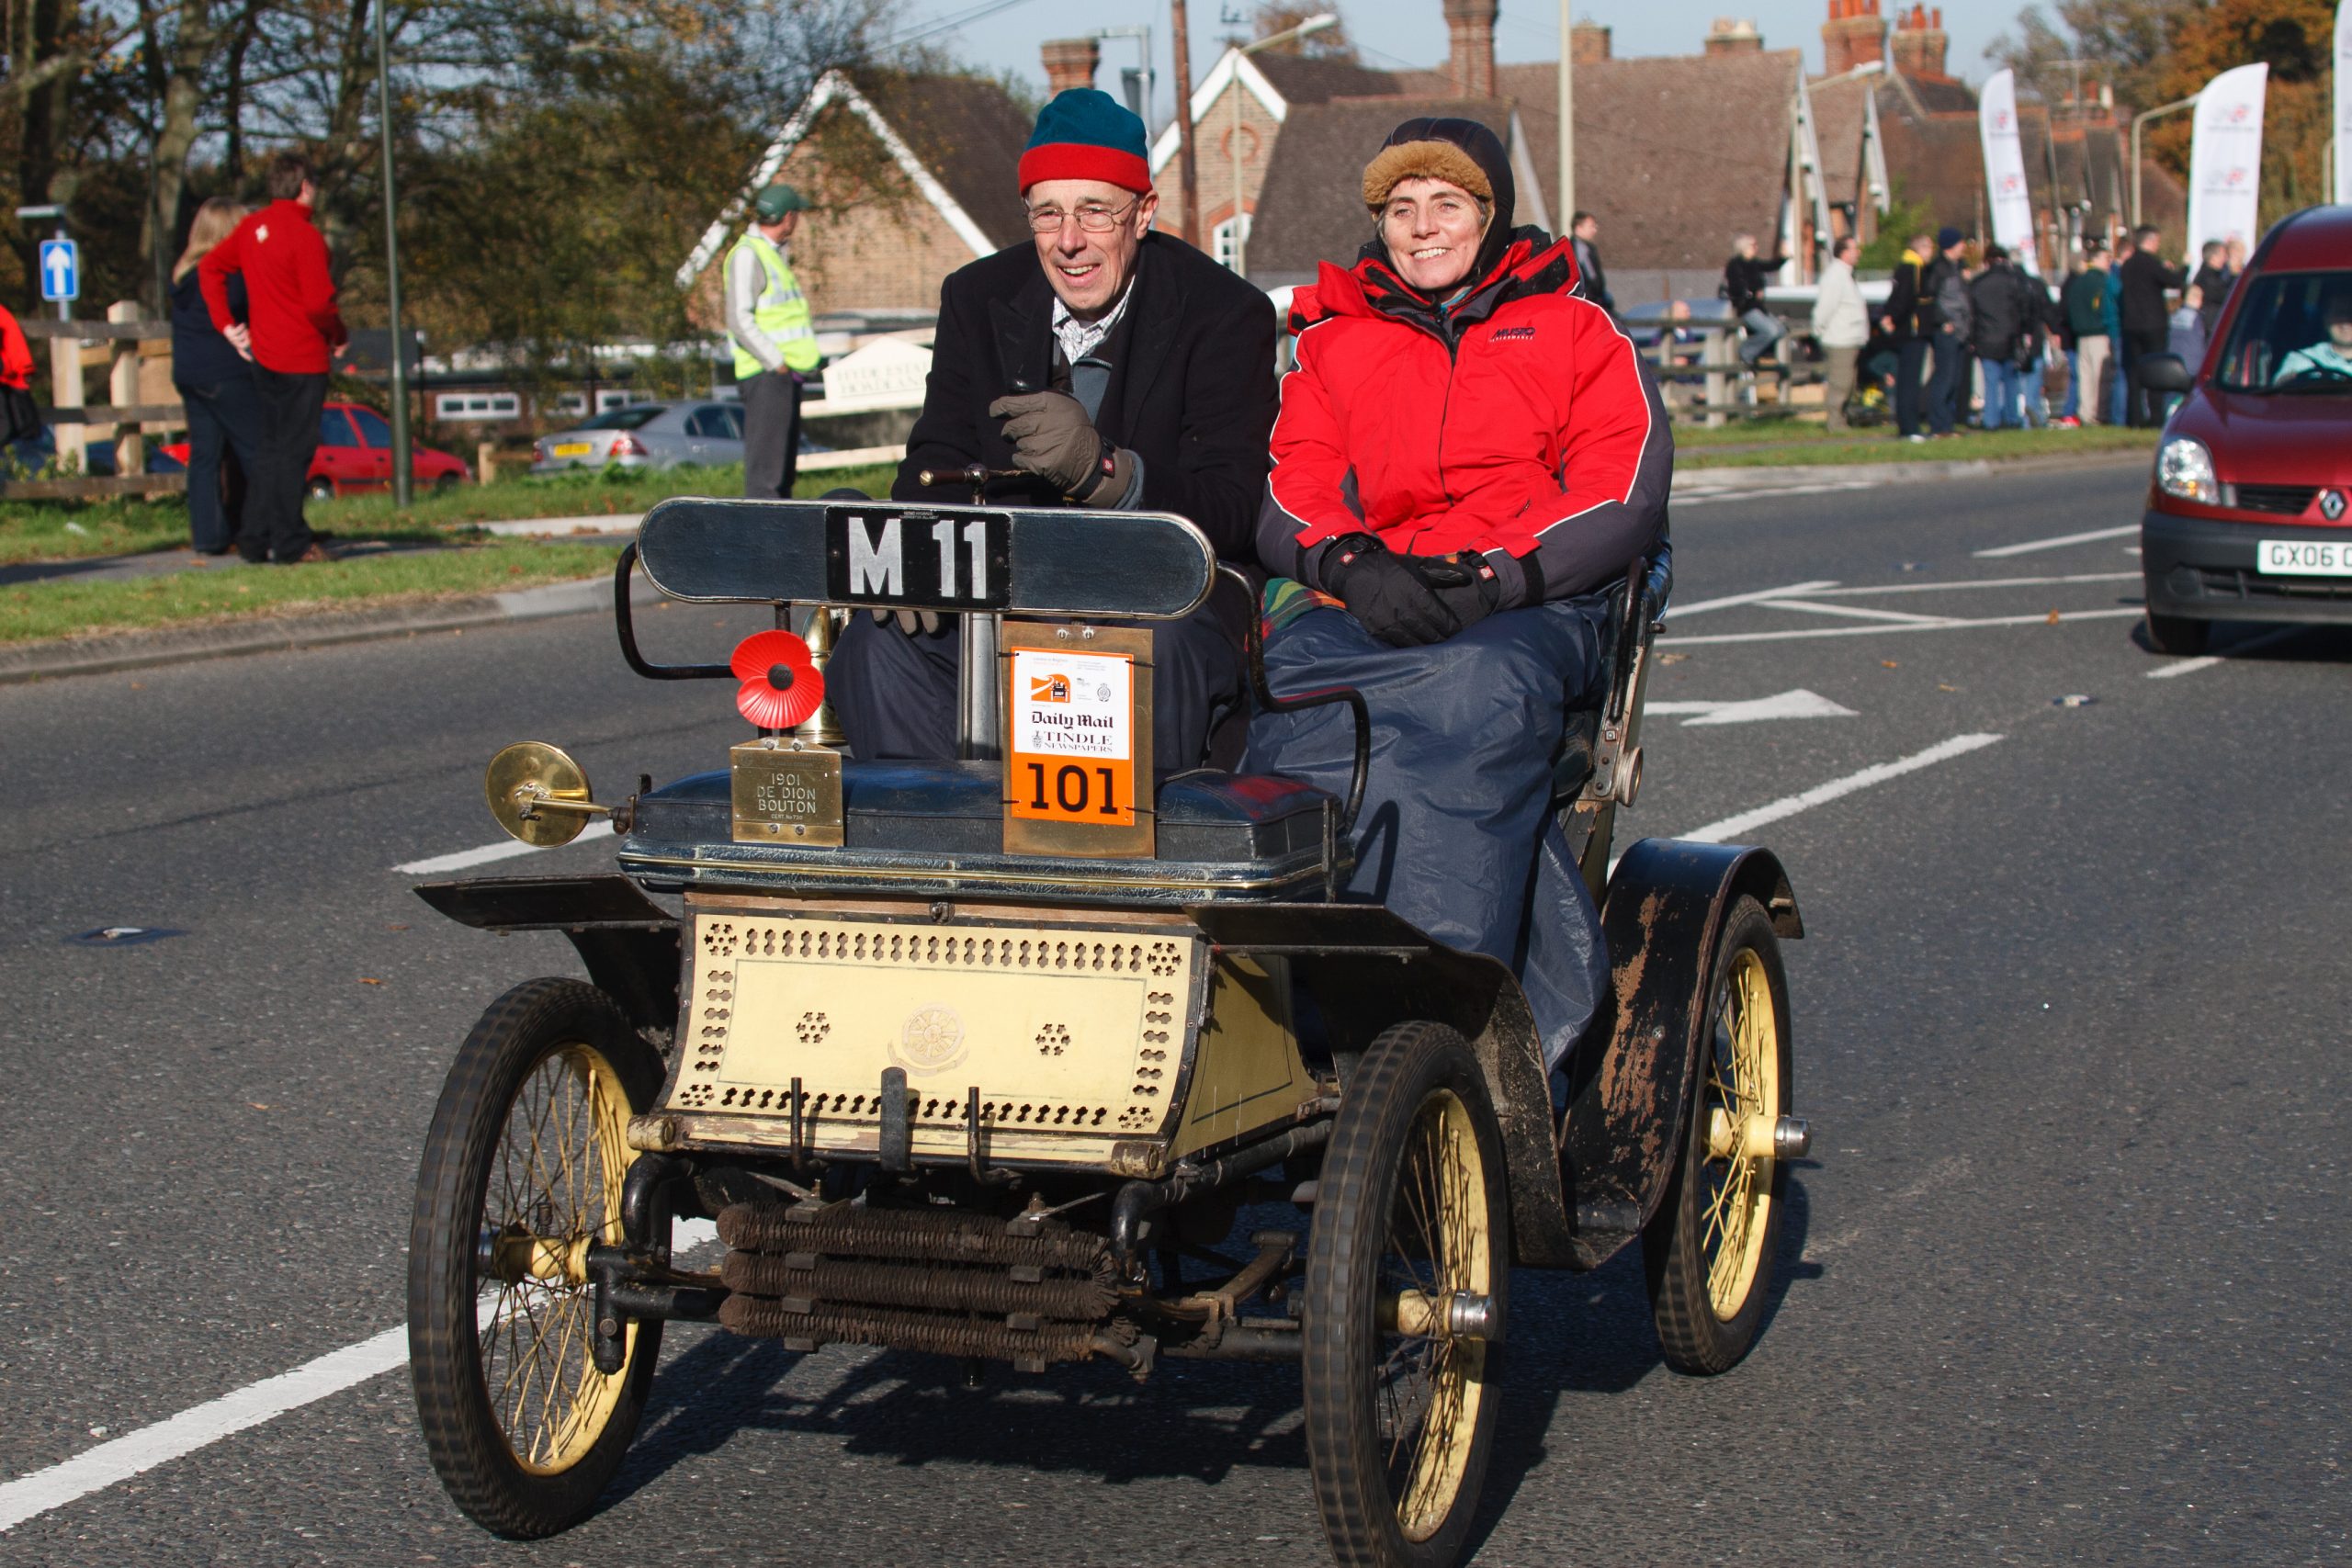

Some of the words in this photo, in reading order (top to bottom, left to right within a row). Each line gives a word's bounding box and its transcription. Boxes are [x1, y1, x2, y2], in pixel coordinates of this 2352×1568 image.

[848, 516, 904, 596] M
[932, 519, 987, 600] 11
[2271, 545, 2335, 567] GX06
[1031, 710, 1074, 729] Daily
[1077, 713, 1114, 728] Mail
[1044, 730, 1113, 746] TINDLE
[1044, 741, 1113, 753] NEWSPAPERS
[772, 773, 800, 786] 1901
[757, 785, 775, 798] DE
[782, 786, 816, 800] DION
[1027, 762, 1118, 815] 101
[758, 798, 816, 814] BOUTON
